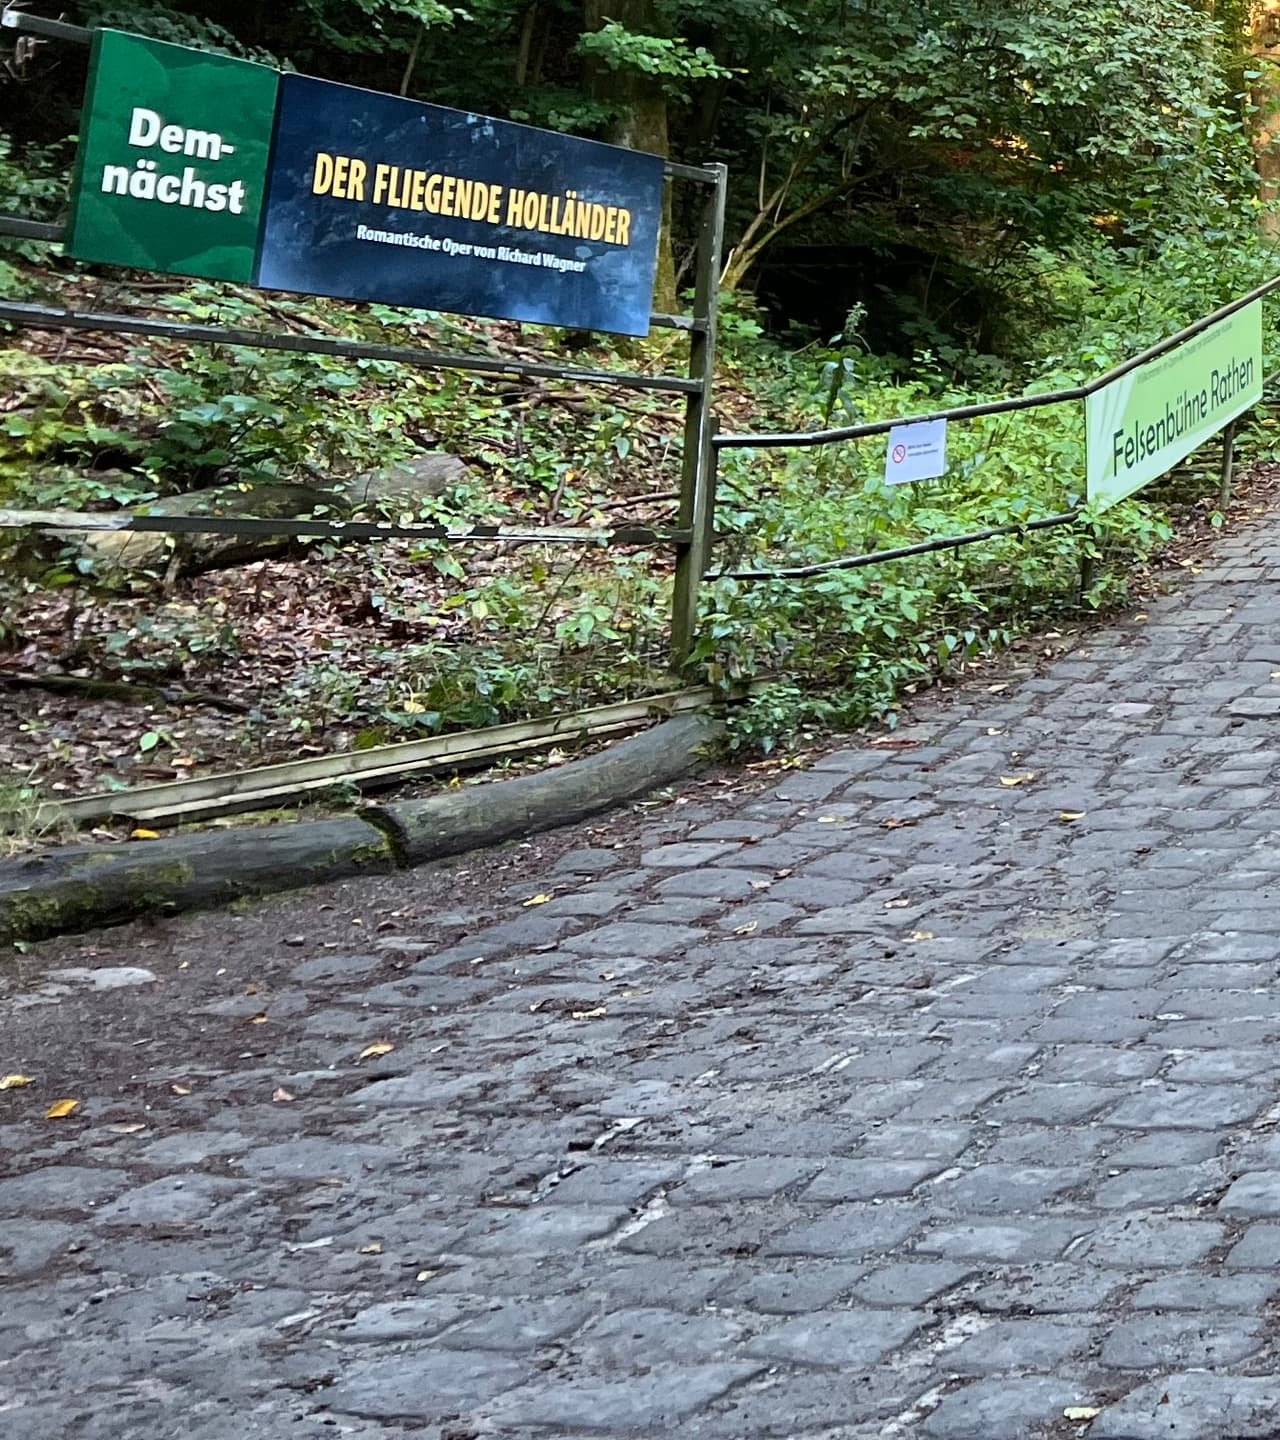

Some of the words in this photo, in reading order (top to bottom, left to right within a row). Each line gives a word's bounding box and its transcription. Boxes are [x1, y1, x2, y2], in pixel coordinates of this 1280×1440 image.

[128, 107, 234, 160] Dem-
[101, 158, 245, 214] nächst
[312, 152, 367, 201] DER
[372, 163, 503, 224] FLIEGENDE
[506, 189, 631, 245] HOLLÄNDER
[356, 224, 441, 251] Romantische
[442, 239, 472, 256] Oper
[473, 245, 496, 259] von
[497, 247, 542, 266] Richard
[543, 253, 586, 273] Wagner
[1113, 389, 1208, 477] Felsenbühne
[1211, 357, 1254, 411] Rathen
